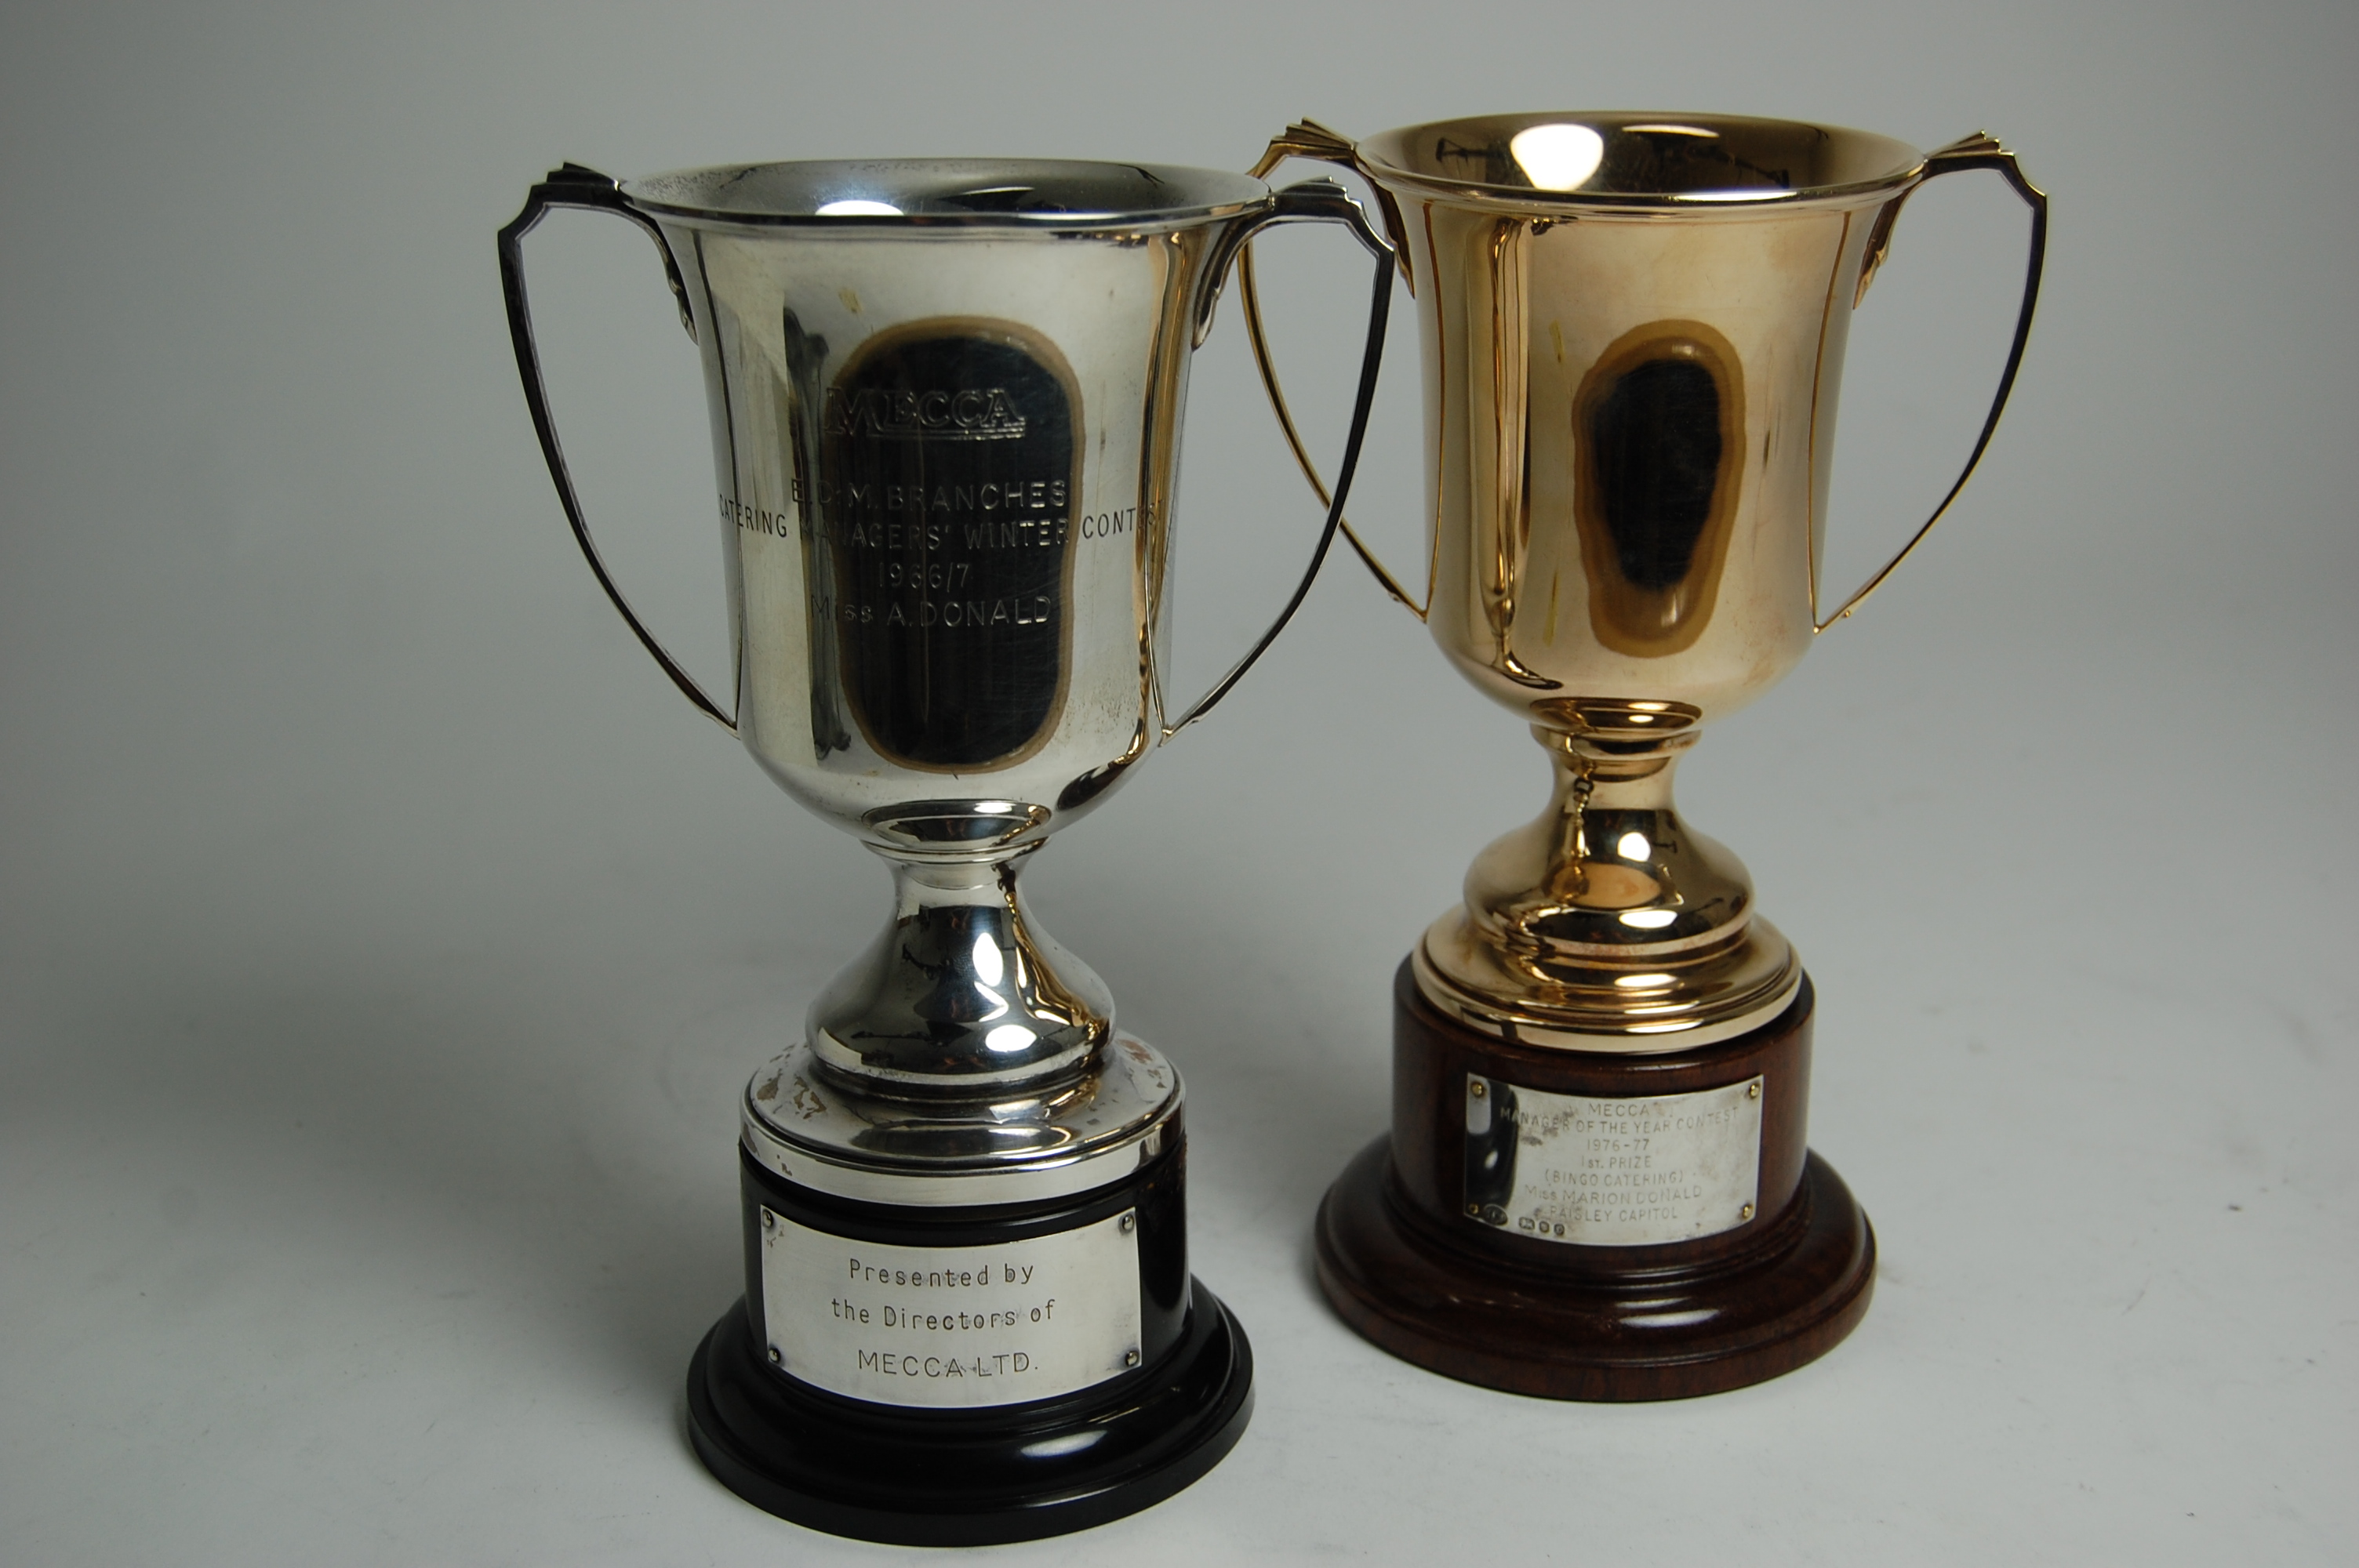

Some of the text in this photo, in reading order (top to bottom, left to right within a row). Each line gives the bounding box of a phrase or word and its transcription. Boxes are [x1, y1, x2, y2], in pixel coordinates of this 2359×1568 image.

[824, 387, 1027, 437] MECCA
[887, 479, 1067, 512] BRANCHES
[718, 492, 788, 539] CATERING
[963, 518, 1070, 549] WINTER
[878, 563, 972, 593] 1966/7
[1499, 1105, 1739, 1134] MANAGER OF THE YEAR CONTEST
[1587, 1103, 1649, 1118] MECCA
[1587, 1138, 1650, 1152] 1976-77
[1608, 1155, 1652, 1169] PRIZE
[1544, 1168, 1685, 1187] (BINGO CATERING)
[1562, 1189, 1631, 1205] MARION
[1636, 1184, 1703, 1204] DONALD
[1549, 1206, 1679, 1222] PAISLEY CAPITOL
[849, 1258, 1034, 1287] Presented by
[831, 1298, 1056, 1330] the Directors of
[858, 1349, 1038, 1377] MECCA LTD.
